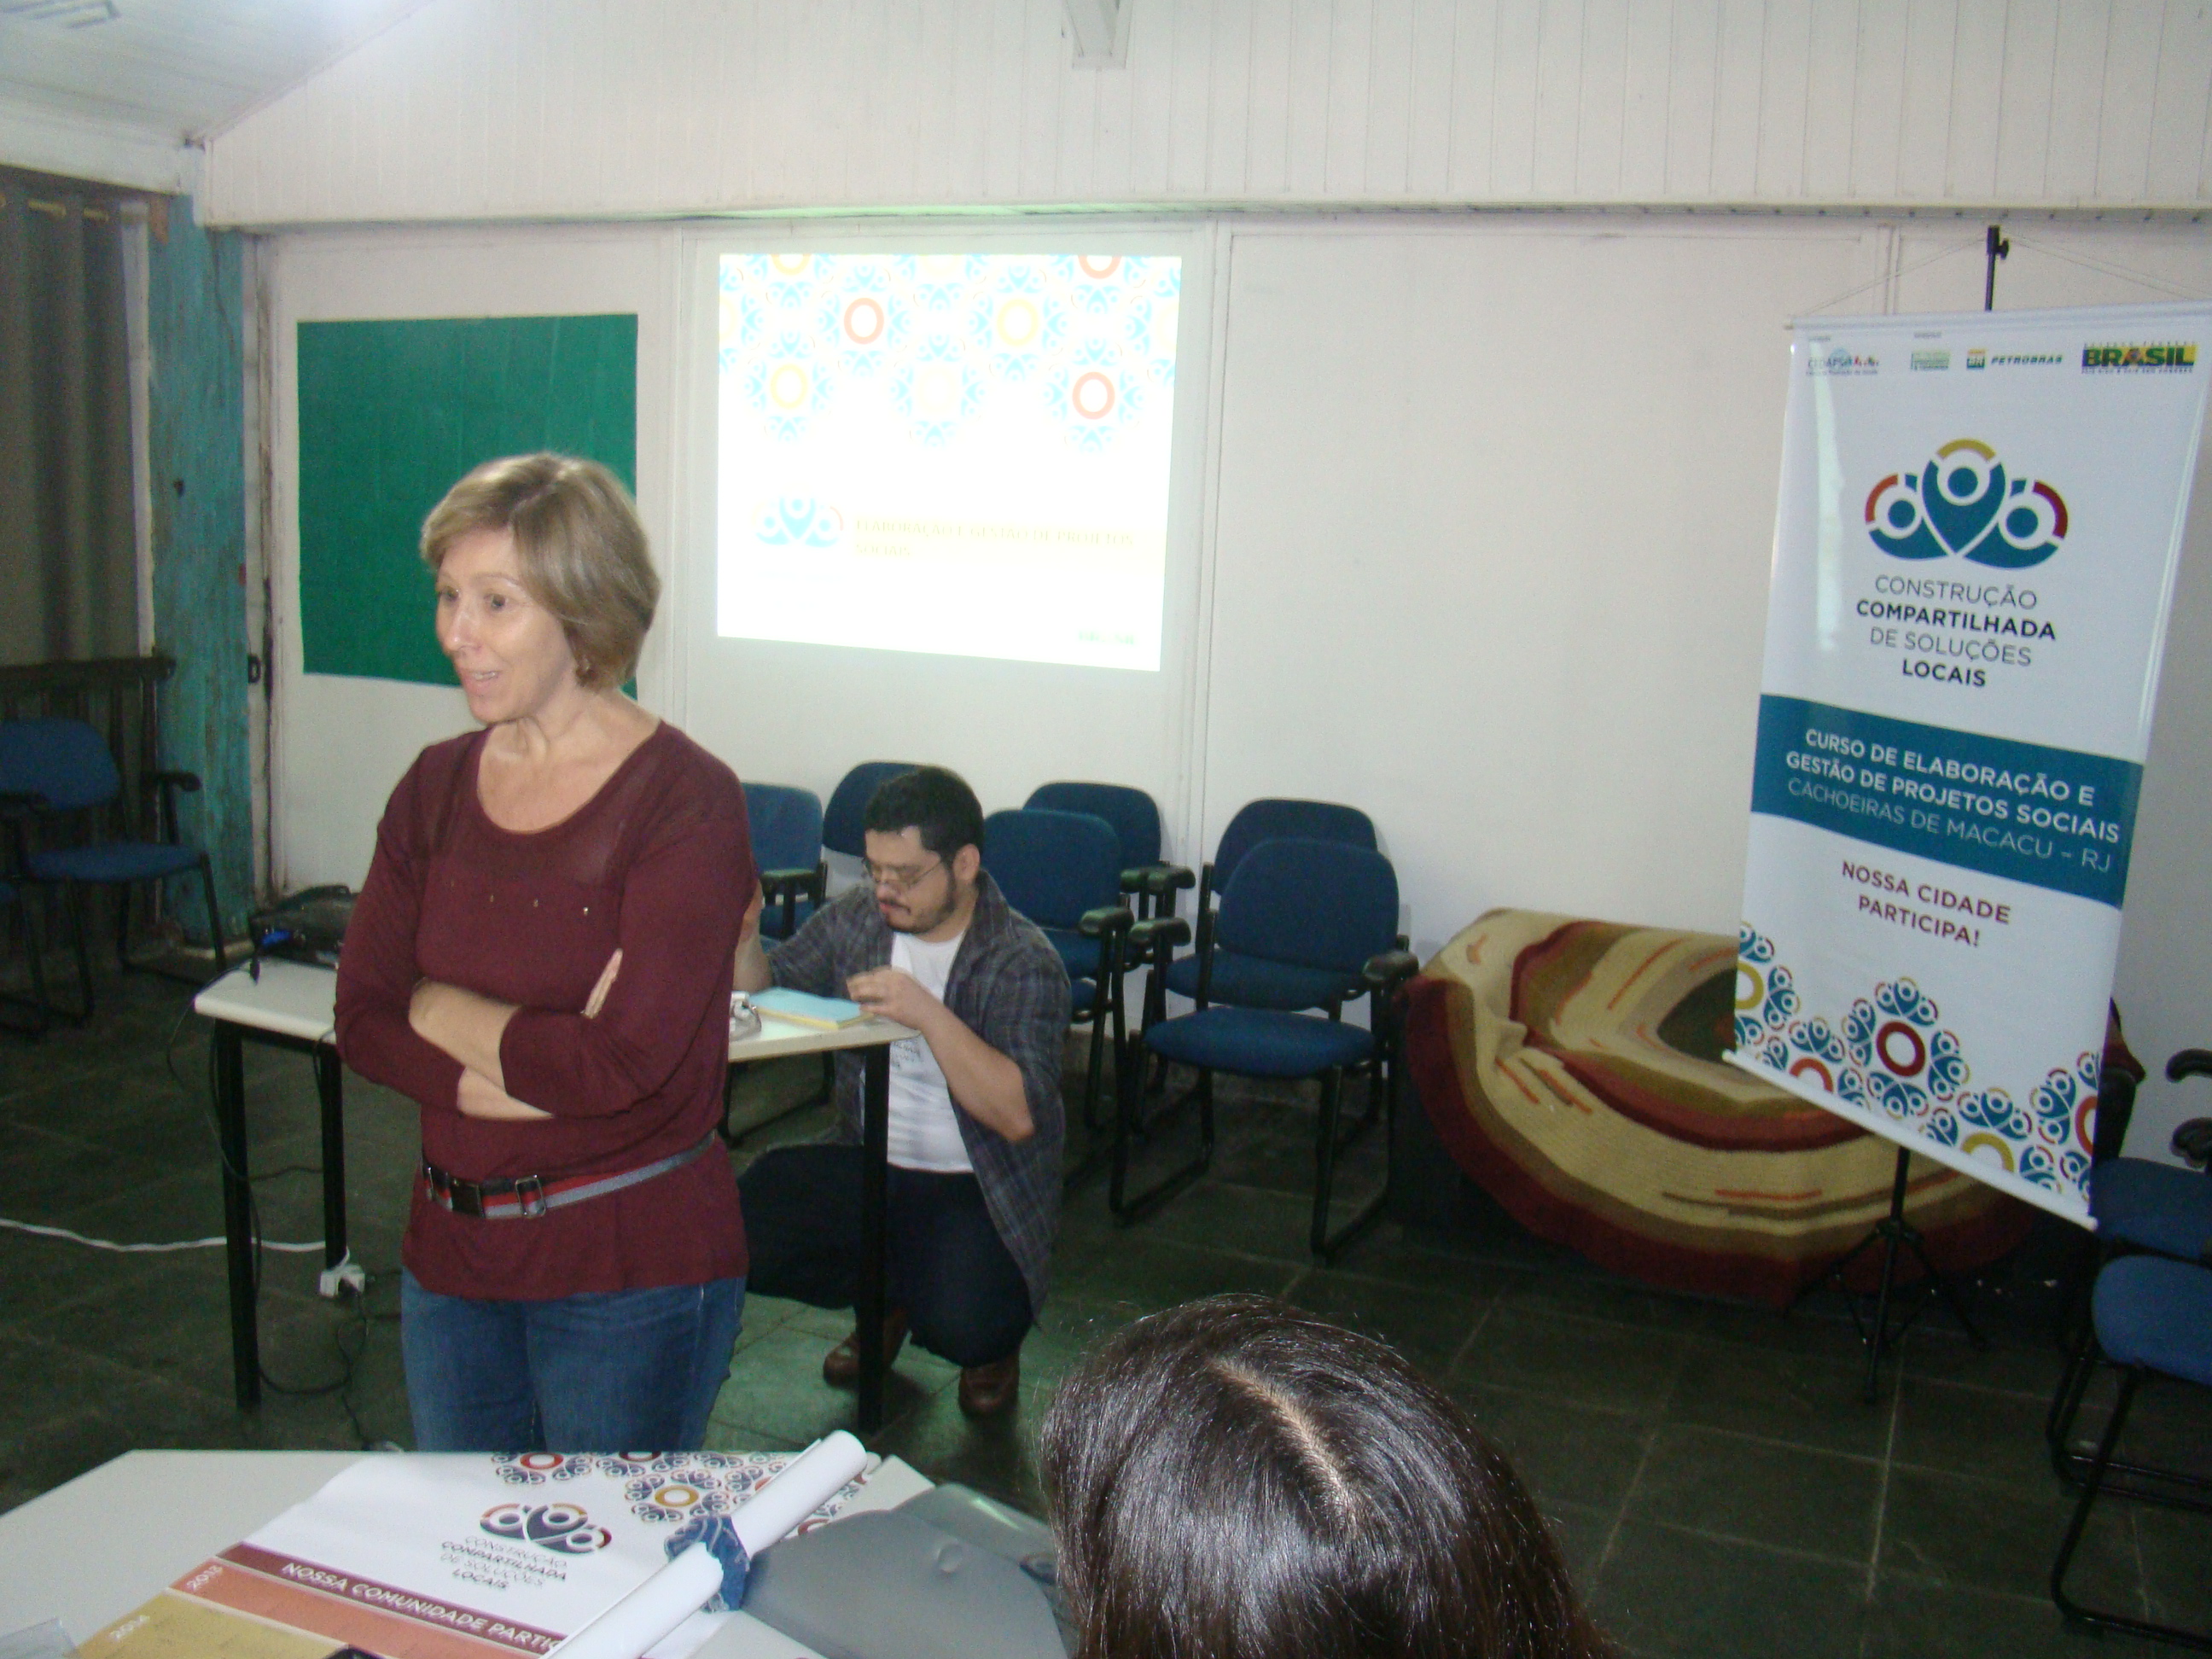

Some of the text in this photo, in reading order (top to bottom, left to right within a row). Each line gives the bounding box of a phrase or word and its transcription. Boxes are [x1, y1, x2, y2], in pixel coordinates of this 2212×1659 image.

[1991, 354, 2063, 365] PETROBRAS
[2081, 346, 2195, 367] BRASIL
[856, 543, 911, 558] SOCIAIS
[1034, 527, 1052, 542] DE
[1057, 530, 1133, 547] PROJETOS
[1875, 574, 2037, 609] CONSTRUÇÃO
[1857, 600, 2056, 639] COMPARTILHADA
[1871, 627, 2031, 666] DE SOLUÇÕES
[1902, 660, 1986, 686] LOCAIS
[1805, 729, 2094, 806] CURSO DE ELABORAÇÃO E
[1786, 751, 2119, 843] GESTÃO DE PROJETOS SOCIAIS
[1789, 777, 1905, 824] CACHOEIRAS
[1911, 808, 1939, 834] DE
[1947, 817, 2052, 859] MACACU
[2082, 848, 2110, 873] RJ
[1842, 860, 2011, 923] NOSSA CIDADE
[1859, 894, 1980, 946] PARTICIPA!
[187, 1565, 223, 1592] 2013
[442, 1541, 566, 1580] COMPARTILHADA
[452, 1569, 508, 1589] LOCAIS
[282, 1563, 347, 1591] NOSSA
[352, 1583, 488, 1631] COMUNIDADE
